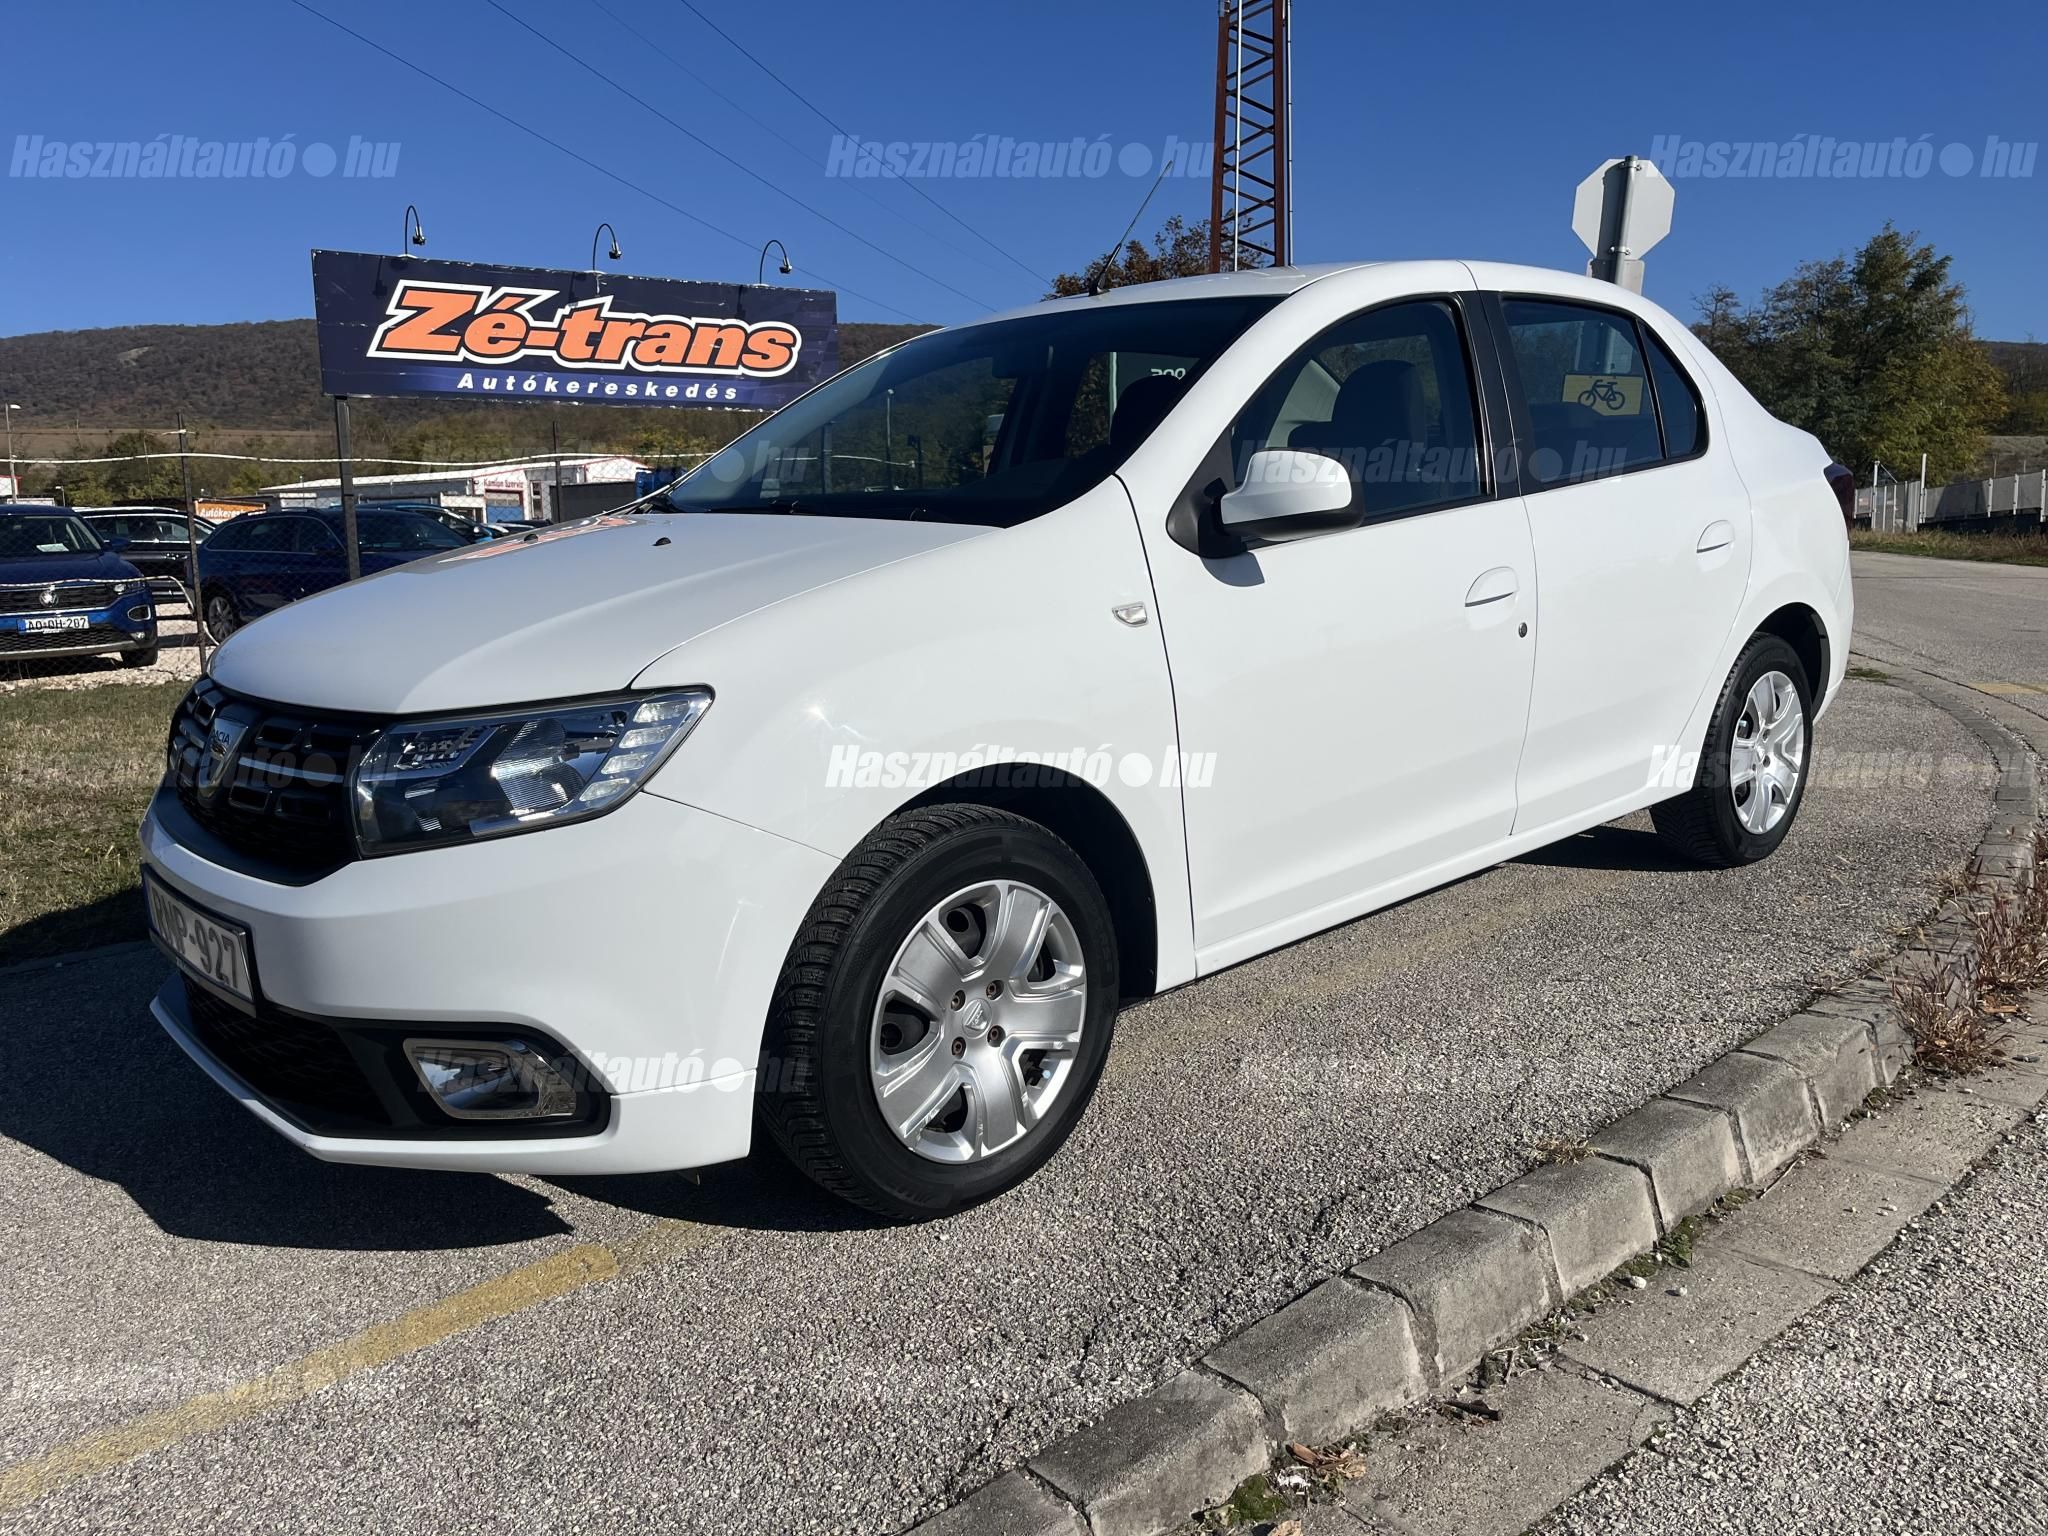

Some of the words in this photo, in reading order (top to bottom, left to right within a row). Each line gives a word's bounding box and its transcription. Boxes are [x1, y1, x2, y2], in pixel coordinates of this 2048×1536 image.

[383, 288, 794, 371] Zé-trans
[457, 372, 738, 400] Autókereskedés
[483, 478, 504, 488] Kamion
[152, 886, 238, 989] RNP-927
